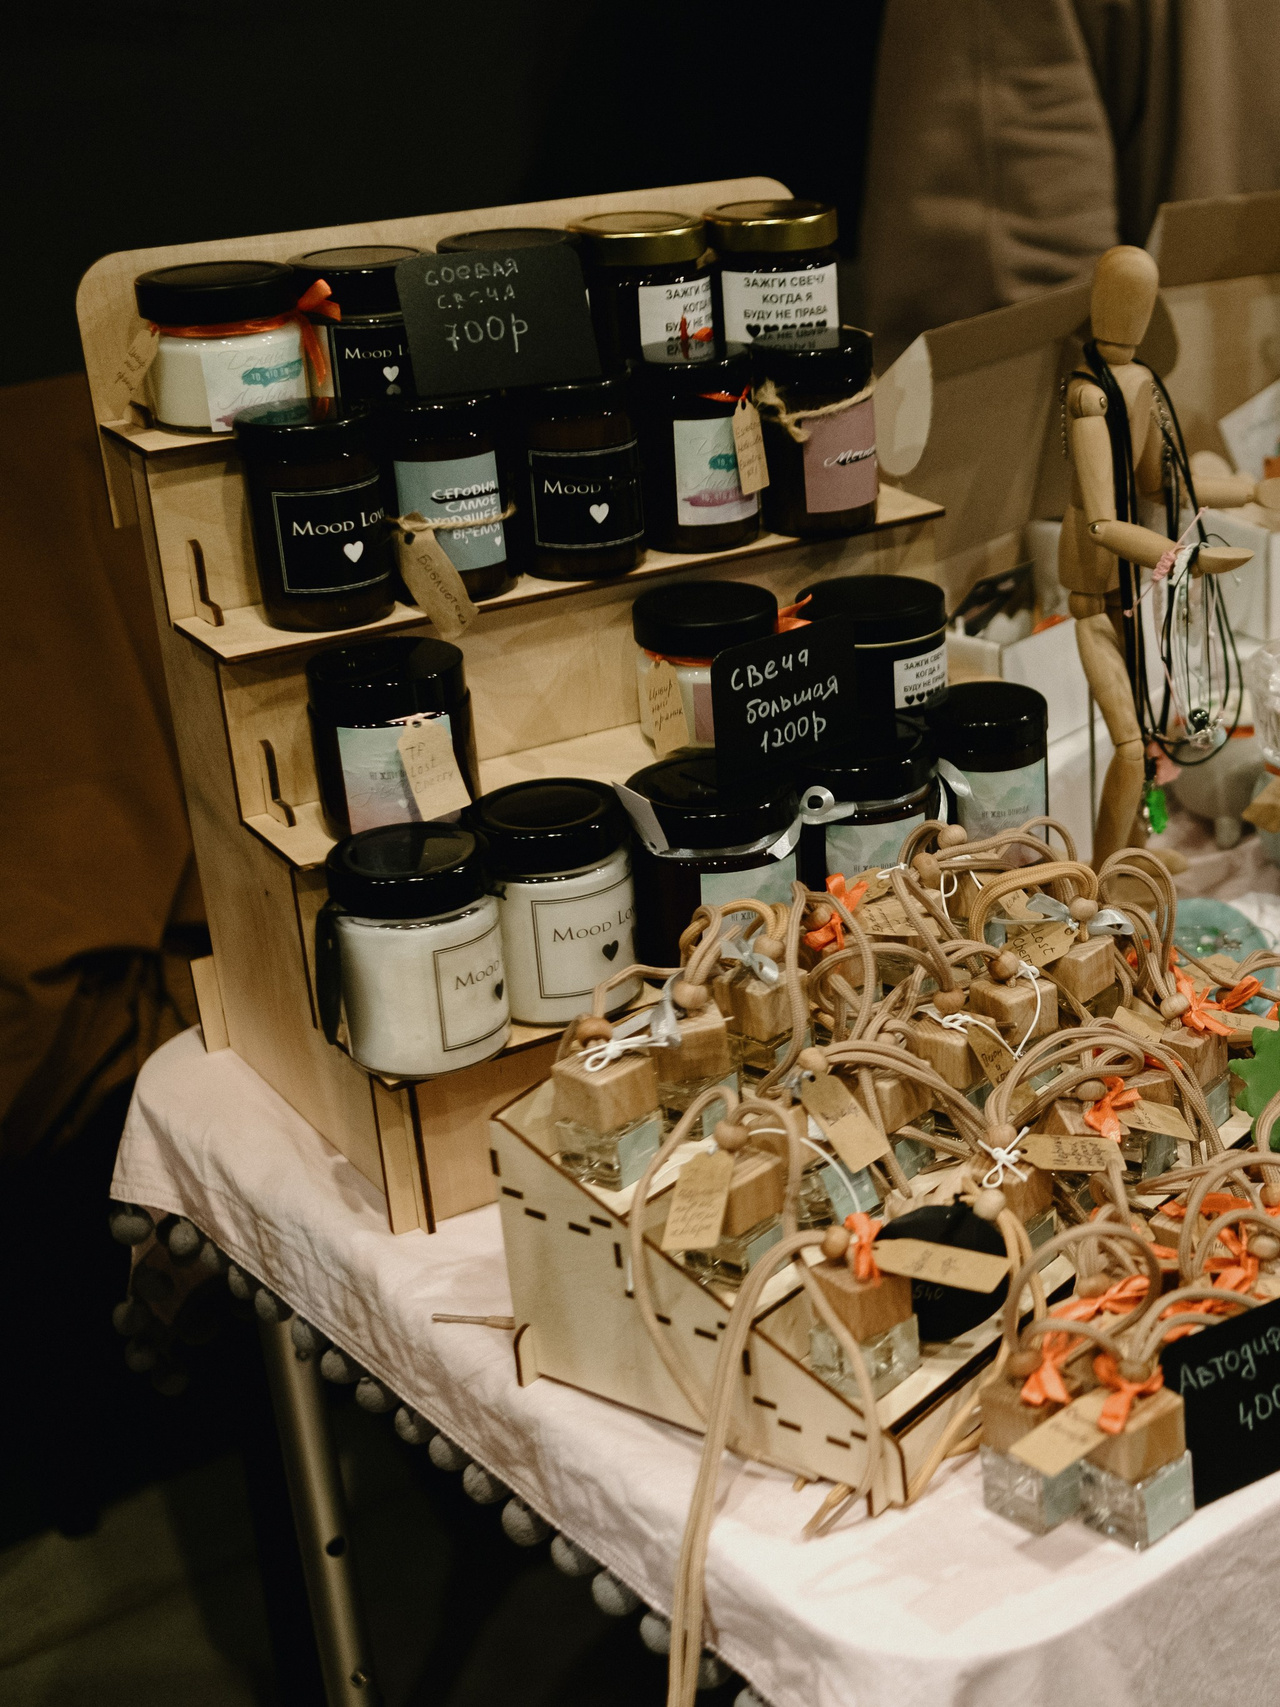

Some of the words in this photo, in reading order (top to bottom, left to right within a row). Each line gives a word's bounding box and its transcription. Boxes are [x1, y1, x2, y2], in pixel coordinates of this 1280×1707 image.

[742, 275, 787, 288] ЗАЖГИ
[789, 272, 825, 286] СВЕЧУ
[665, 285, 700, 300] ЗАЖГИ
[761, 293, 804, 305] КОГДА
[804, 291, 813, 301] Я
[743, 308, 773, 319] БУДУ
[775, 307, 792, 319] НЕ
[794, 304, 828, 317] ПРАВА
[431, 480, 497, 502] СЕГОДНЯ
[903, 658, 930, 671] ЗАЖГИ
[759, 710, 828, 754] 1200р
[1030, 928, 1056, 956] Lost
